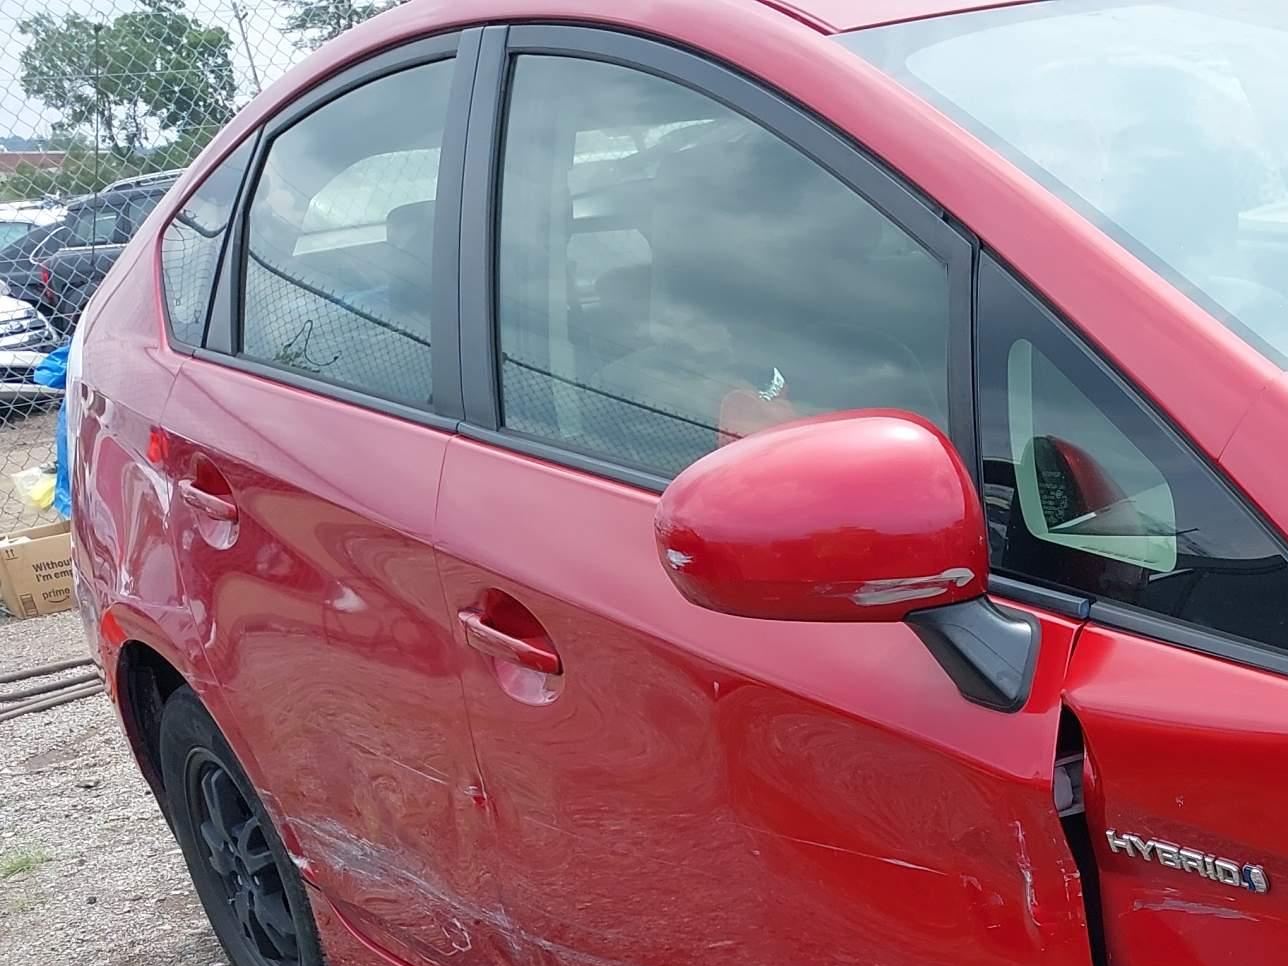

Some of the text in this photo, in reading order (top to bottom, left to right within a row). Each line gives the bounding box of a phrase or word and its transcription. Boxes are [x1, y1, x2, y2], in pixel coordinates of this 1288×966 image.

[35, 573, 53, 583] I'm
[42, 587, 71, 601] prime
[1105, 828, 1241, 888] HYBRID
